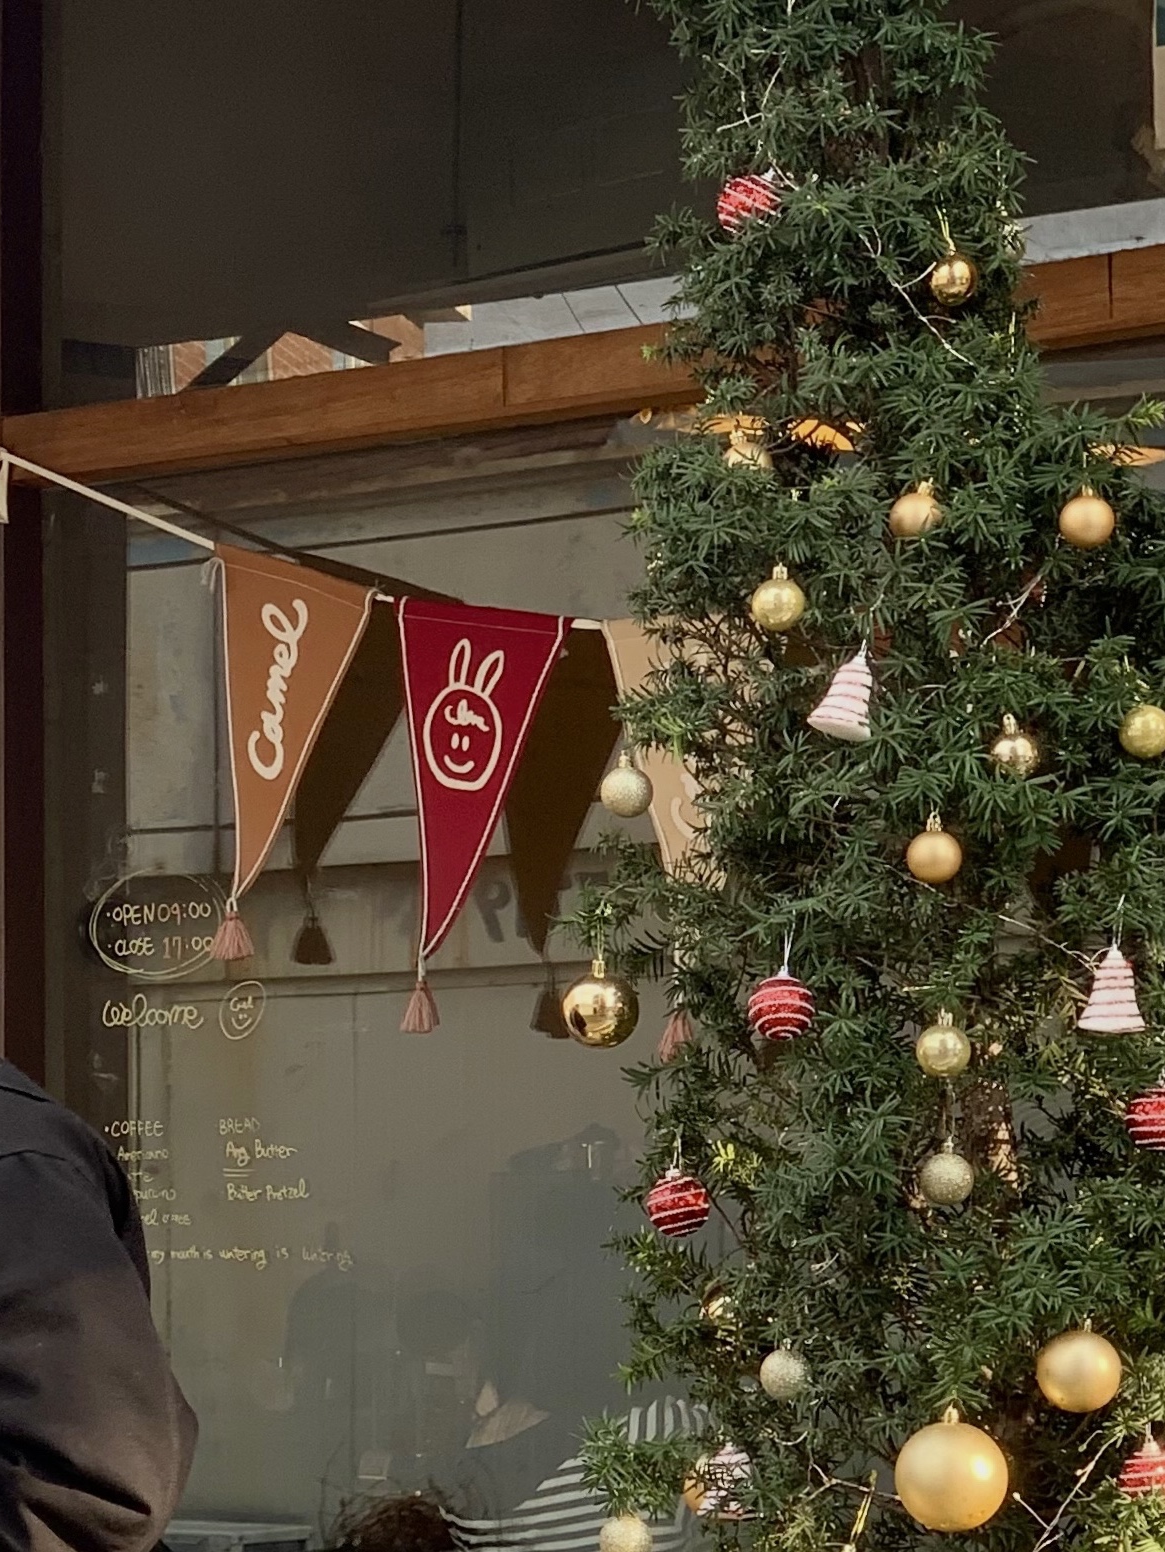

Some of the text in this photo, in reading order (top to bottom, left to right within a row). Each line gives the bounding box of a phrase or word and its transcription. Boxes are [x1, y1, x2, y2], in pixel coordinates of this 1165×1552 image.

[247, 598, 308, 781] Camel
[112, 901, 212, 928] OPEN 09:00
[114, 937, 155, 957] CLOSE
[102, 993, 204, 1029] Welcome
[110, 1119, 164, 1138] COFFEE
[218, 1116, 261, 1136] BREAD
